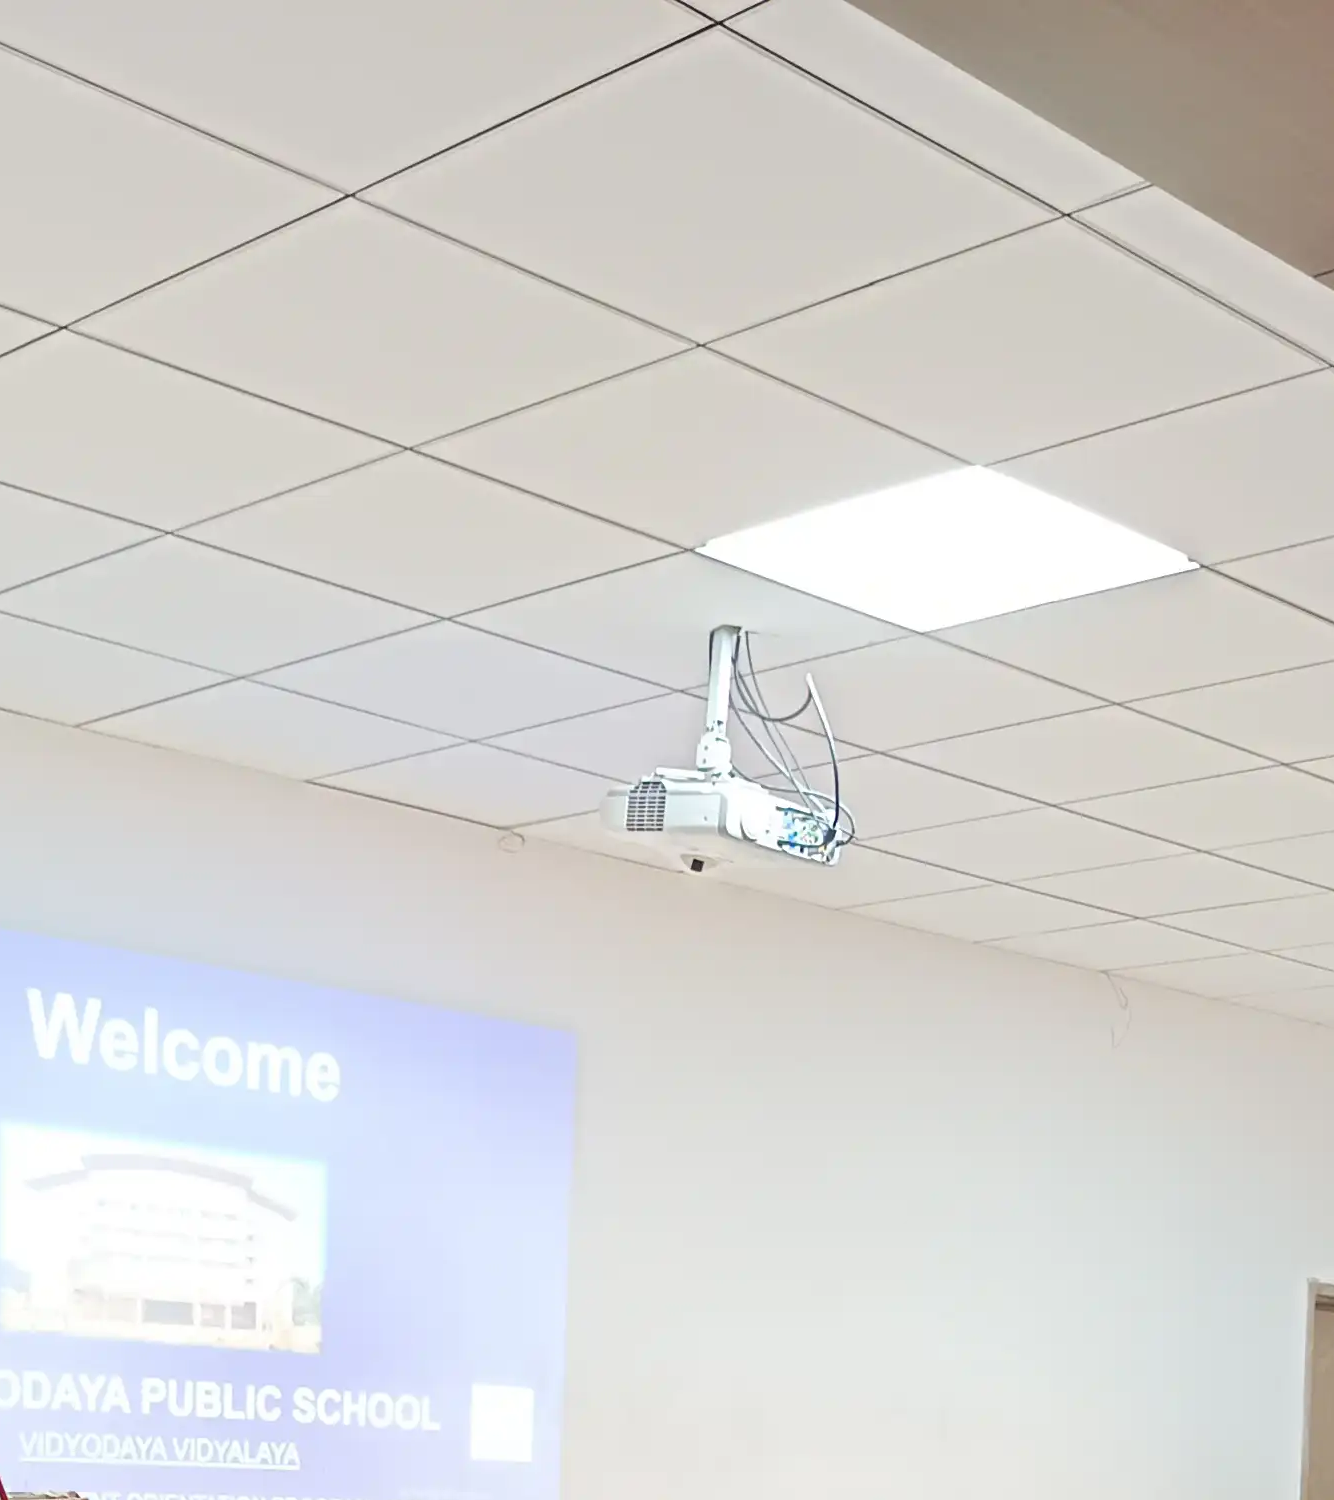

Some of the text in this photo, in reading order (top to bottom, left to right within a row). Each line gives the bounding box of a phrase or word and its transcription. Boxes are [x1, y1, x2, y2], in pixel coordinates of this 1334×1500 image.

[25, 986, 341, 1102] Welcome
[141, 1377, 282, 1421] PUBLIC
[292, 1386, 441, 1431] SCHOOL
[20, 1431, 300, 1465] VIDYODAYA VIDYALAYA
